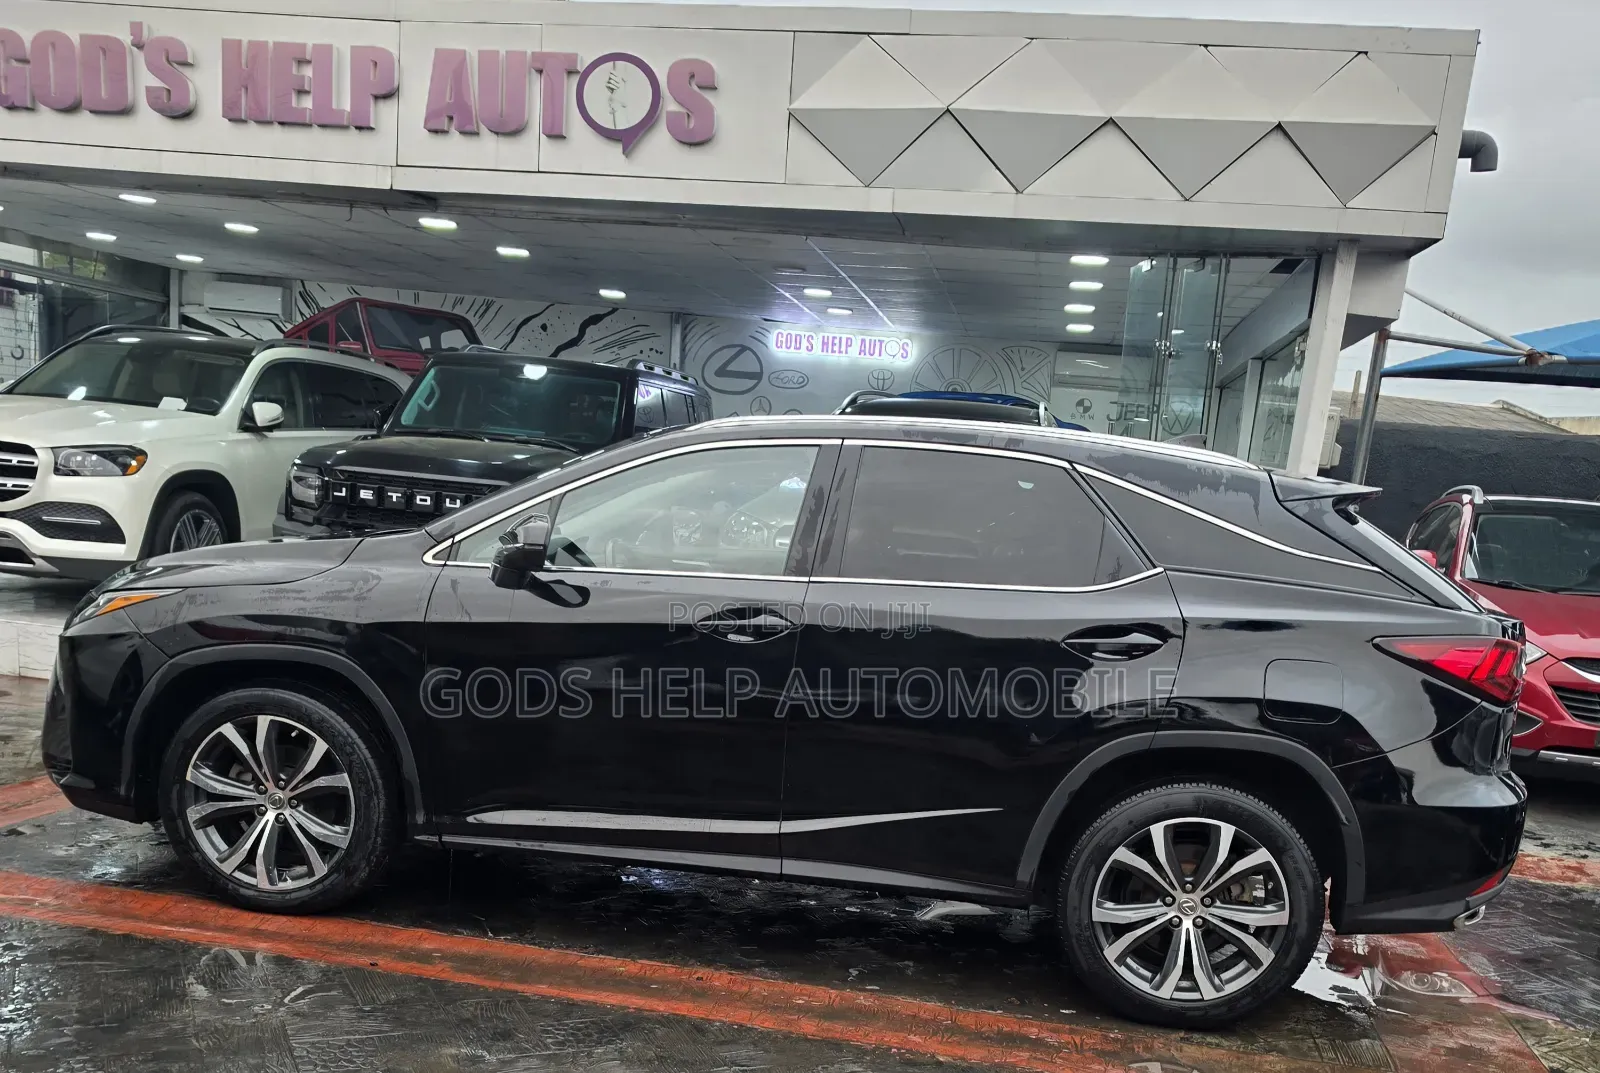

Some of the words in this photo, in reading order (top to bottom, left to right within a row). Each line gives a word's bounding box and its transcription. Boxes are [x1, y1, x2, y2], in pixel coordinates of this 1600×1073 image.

[0, 21, 194, 119] GOD'S
[221, 38, 399, 129] HELP
[424, 48, 719, 156] AUTOS
[775, 331, 815, 353] GOD'S
[820, 335, 853, 355] HELP
[858, 338, 910, 360] AUTOS
[333, 487, 461, 509] JETOU
